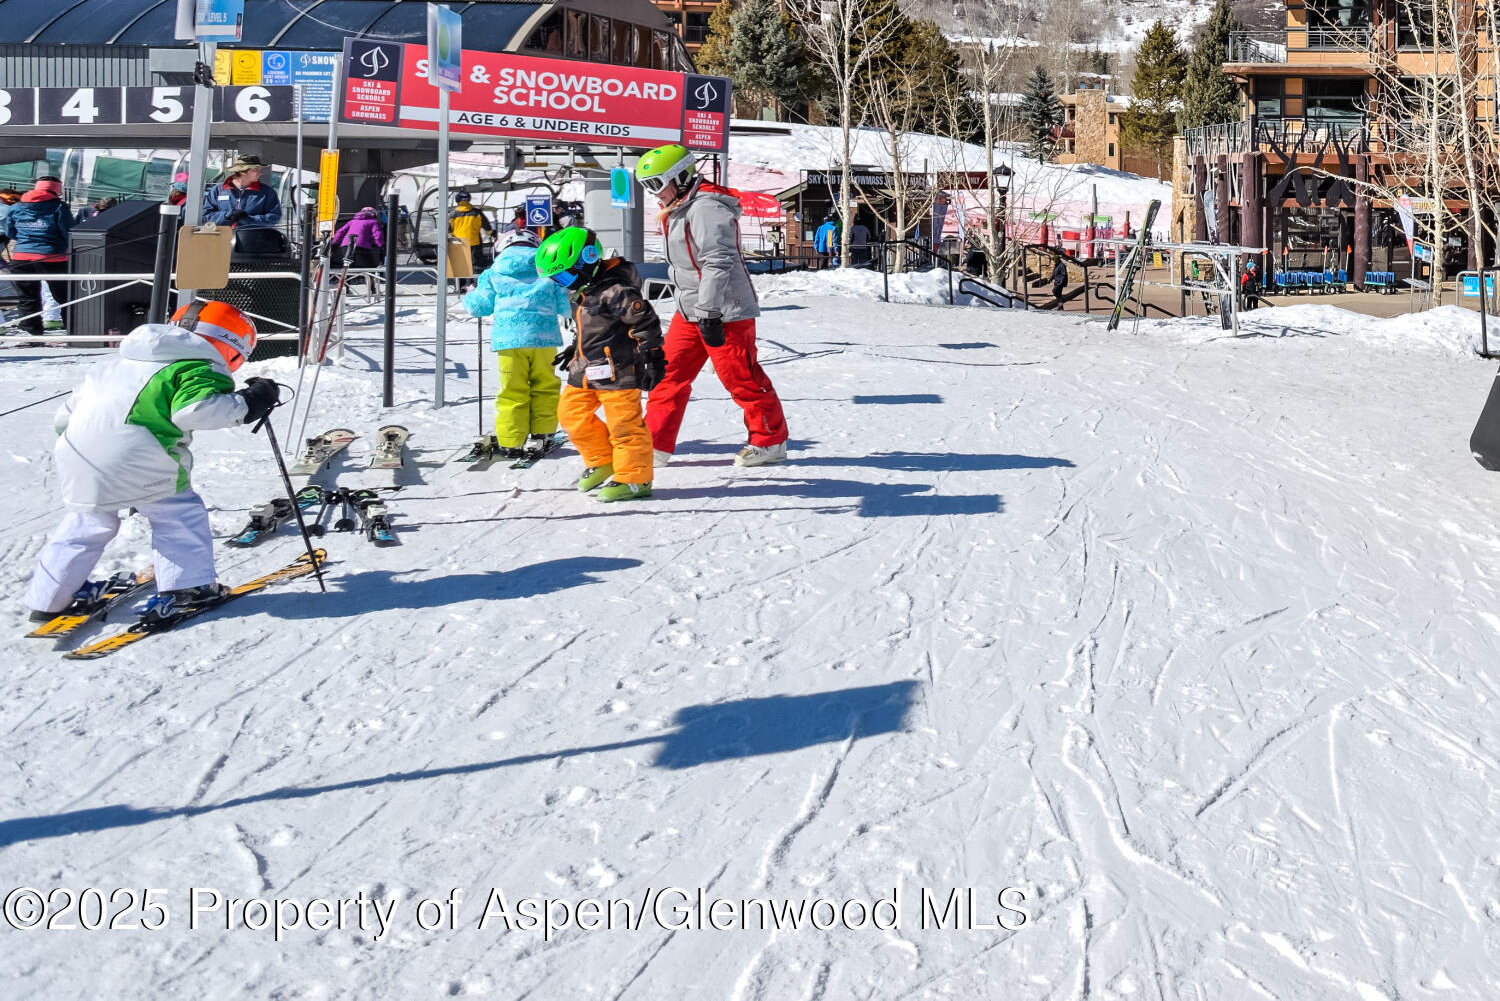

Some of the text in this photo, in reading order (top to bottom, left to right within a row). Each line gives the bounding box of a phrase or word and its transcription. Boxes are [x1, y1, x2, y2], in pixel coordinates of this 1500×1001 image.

[363, 80, 375, 88] SKI
[471, 65, 491, 85] &
[499, 68, 678, 102] SNOWBOARD
[352, 86, 391, 96] SNOWBOARD
[357, 94, 386, 102] SCHOOLS
[493, 86, 607, 114] SCHOOL
[61, 88, 99, 124] 4
[149, 86, 184, 123] 5
[235, 86, 272, 123] 6
[360, 104, 380, 112] ASPEN
[351, 110, 387, 120] SNOWMASS
[457, 112, 631, 137] AGE 6 & UNDER KIDS
[695, 133, 712, 141] ASPEN
[808, 174, 821, 184] SKY
